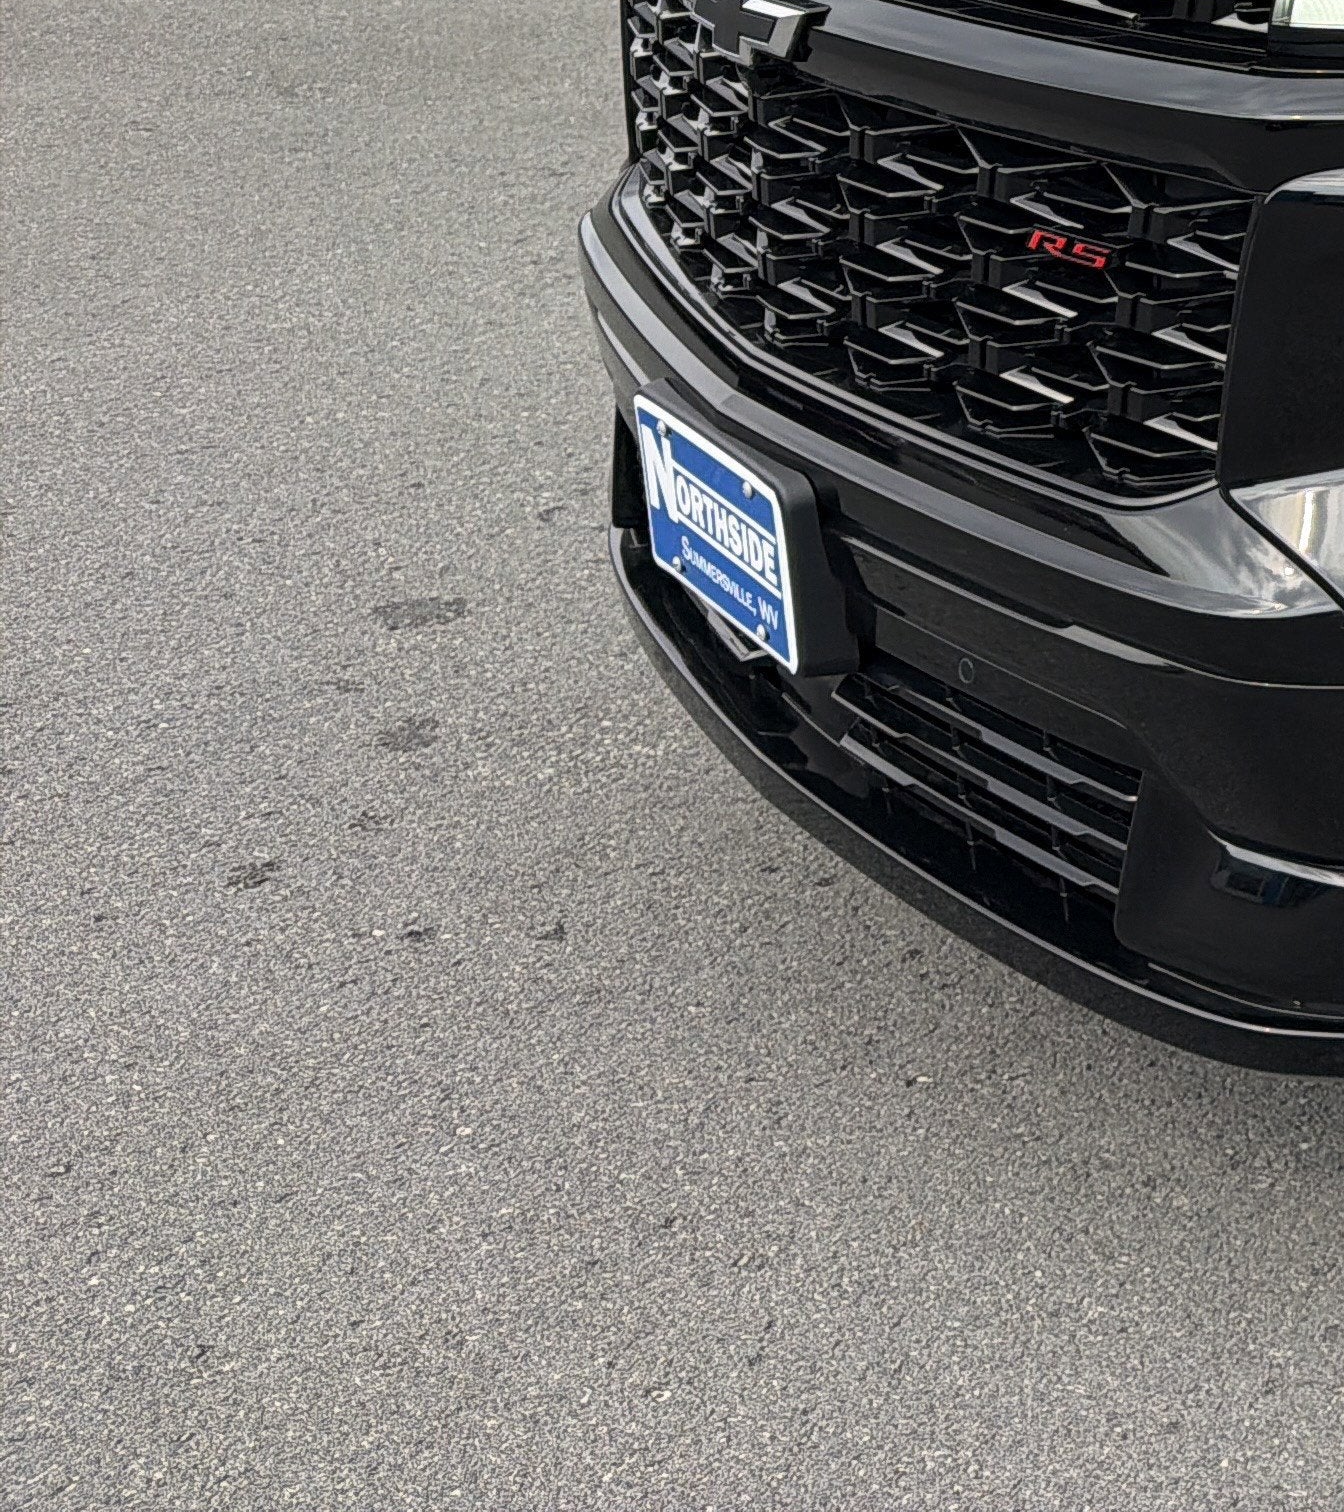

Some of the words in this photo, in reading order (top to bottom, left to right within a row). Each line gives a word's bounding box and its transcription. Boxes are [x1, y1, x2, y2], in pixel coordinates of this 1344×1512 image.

[1028, 229, 1111, 270] RS
[641, 424, 779, 587] NORTHSIDE
[757, 596, 780, 631] WV
